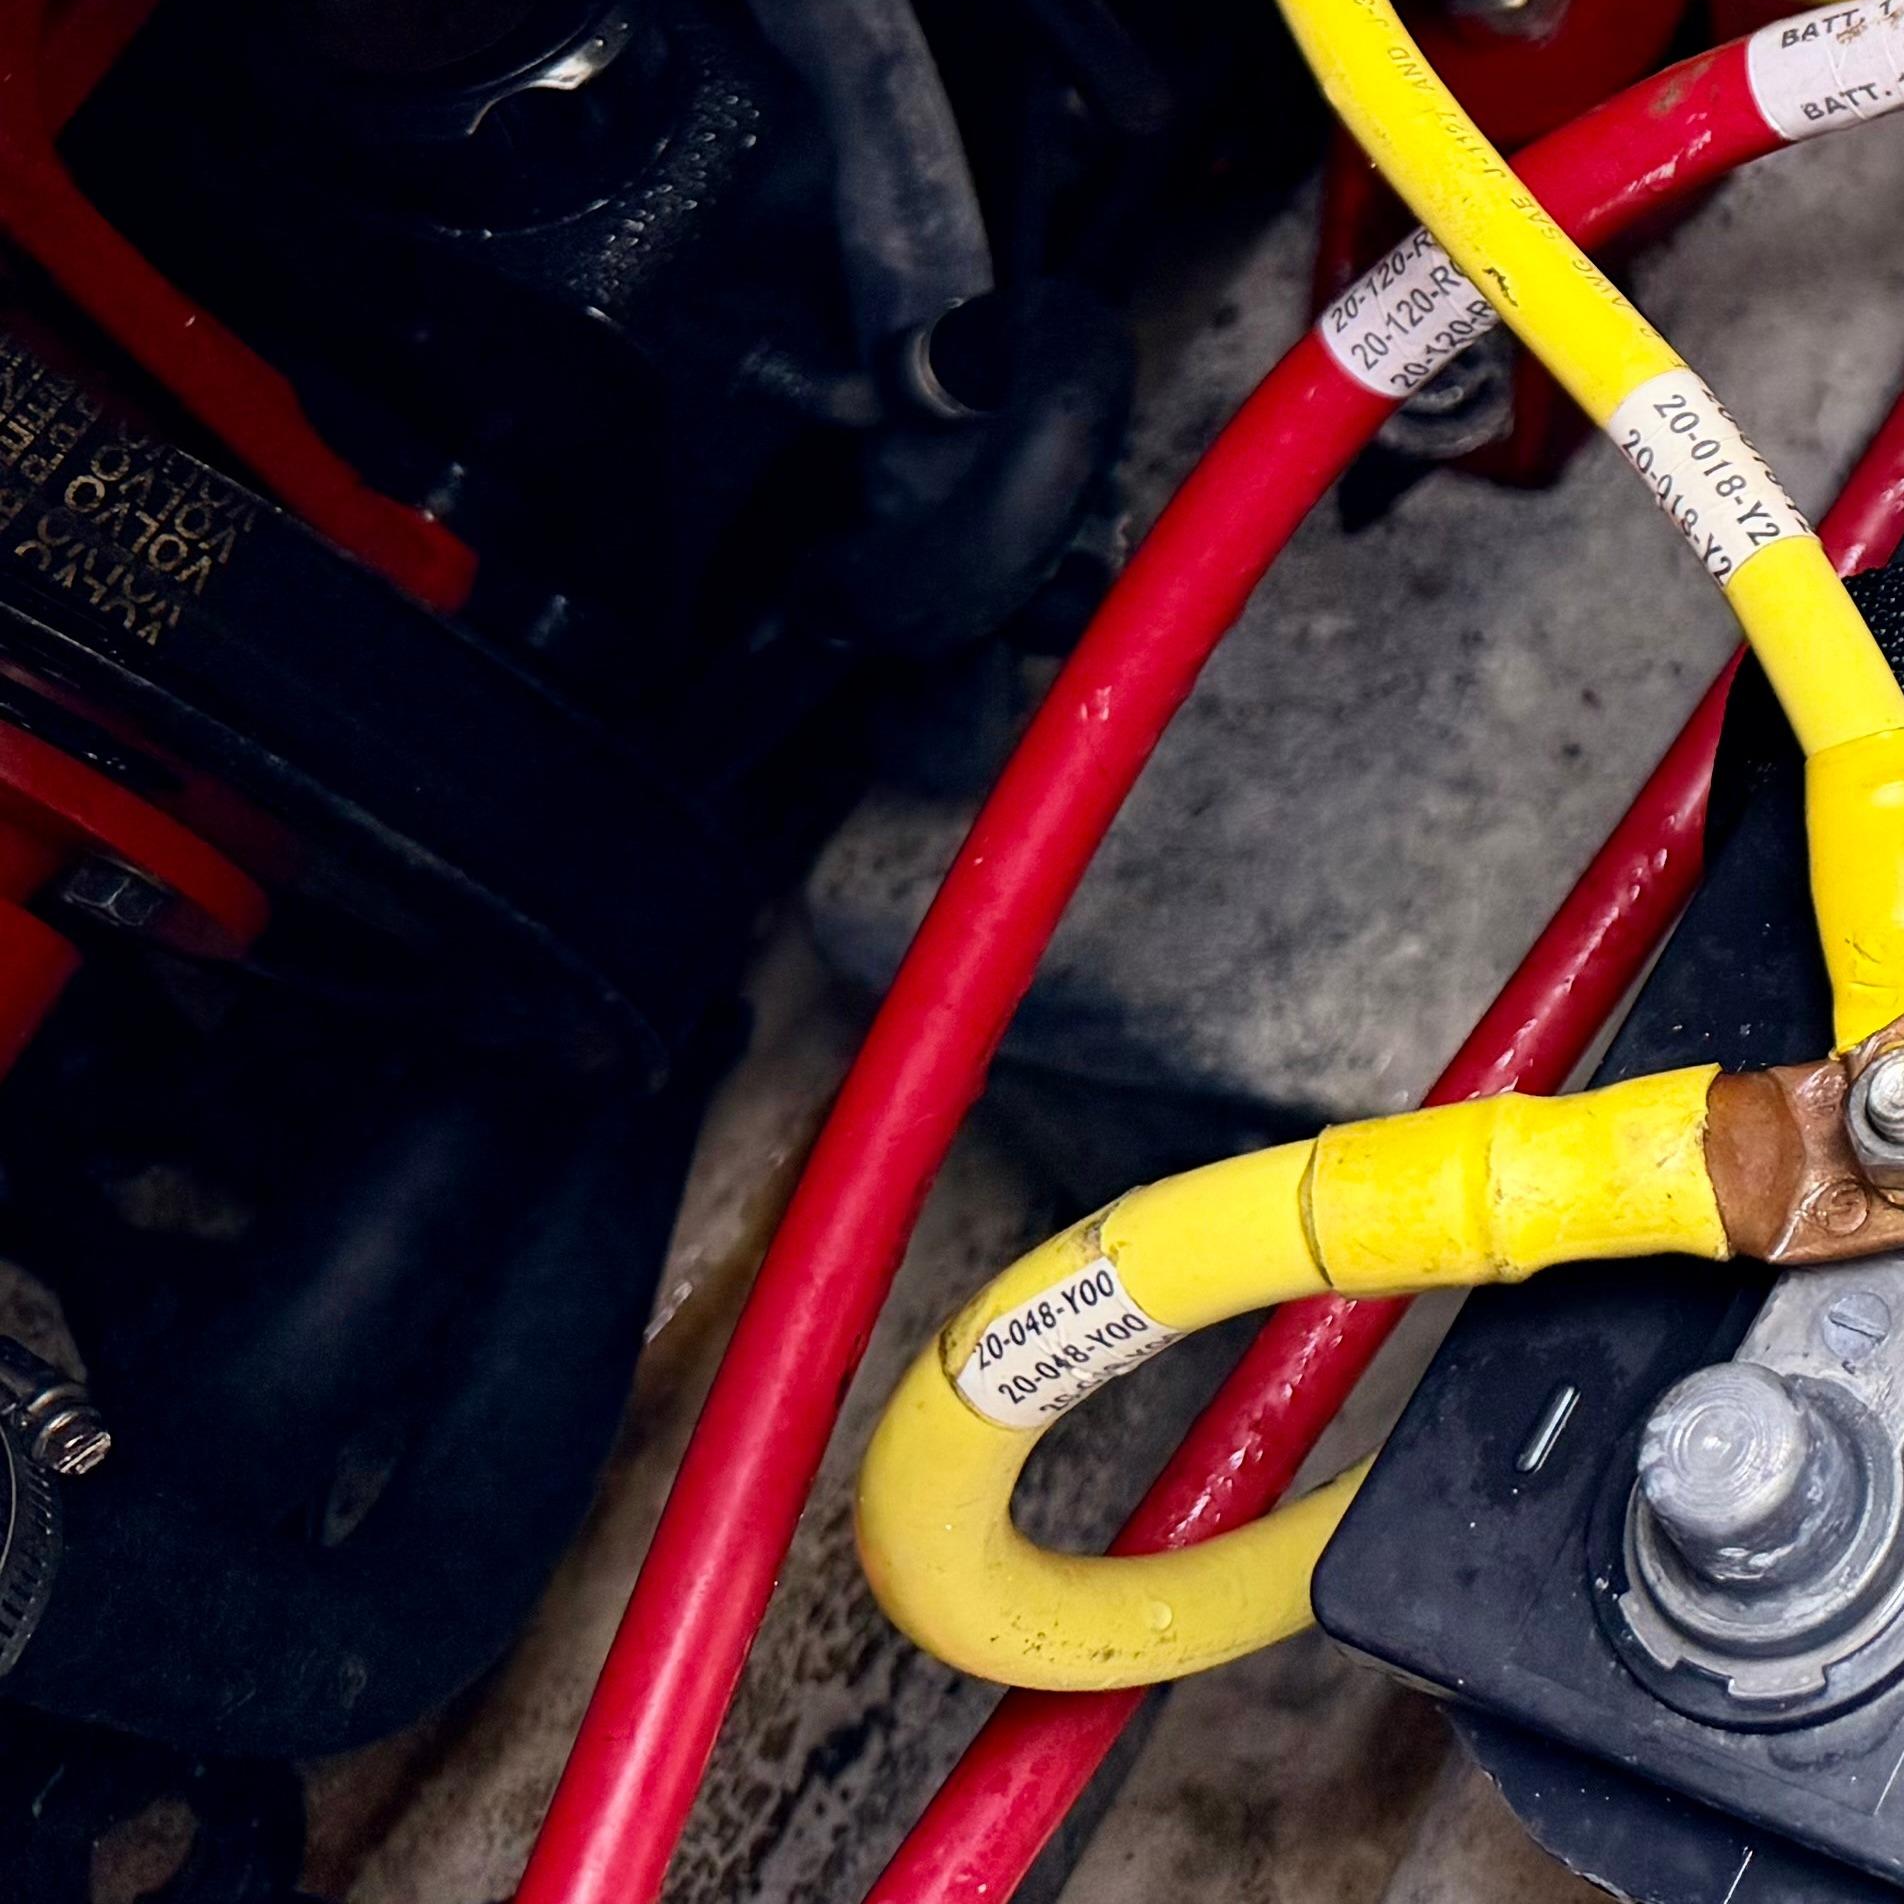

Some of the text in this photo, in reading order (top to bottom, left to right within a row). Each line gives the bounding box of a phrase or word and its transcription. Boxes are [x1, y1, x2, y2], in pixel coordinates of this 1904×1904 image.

[1779, 8, 1865, 48] BATT.
[1802, 80, 1891, 121] BATT.
[1621, 427, 1735, 586] 20-018-Y2
[1653, 392, 1781, 547] 20-018-Y2
[62, 472, 214, 597] VOLVO
[972, 1269, 1115, 1370] 20-048-Y00
